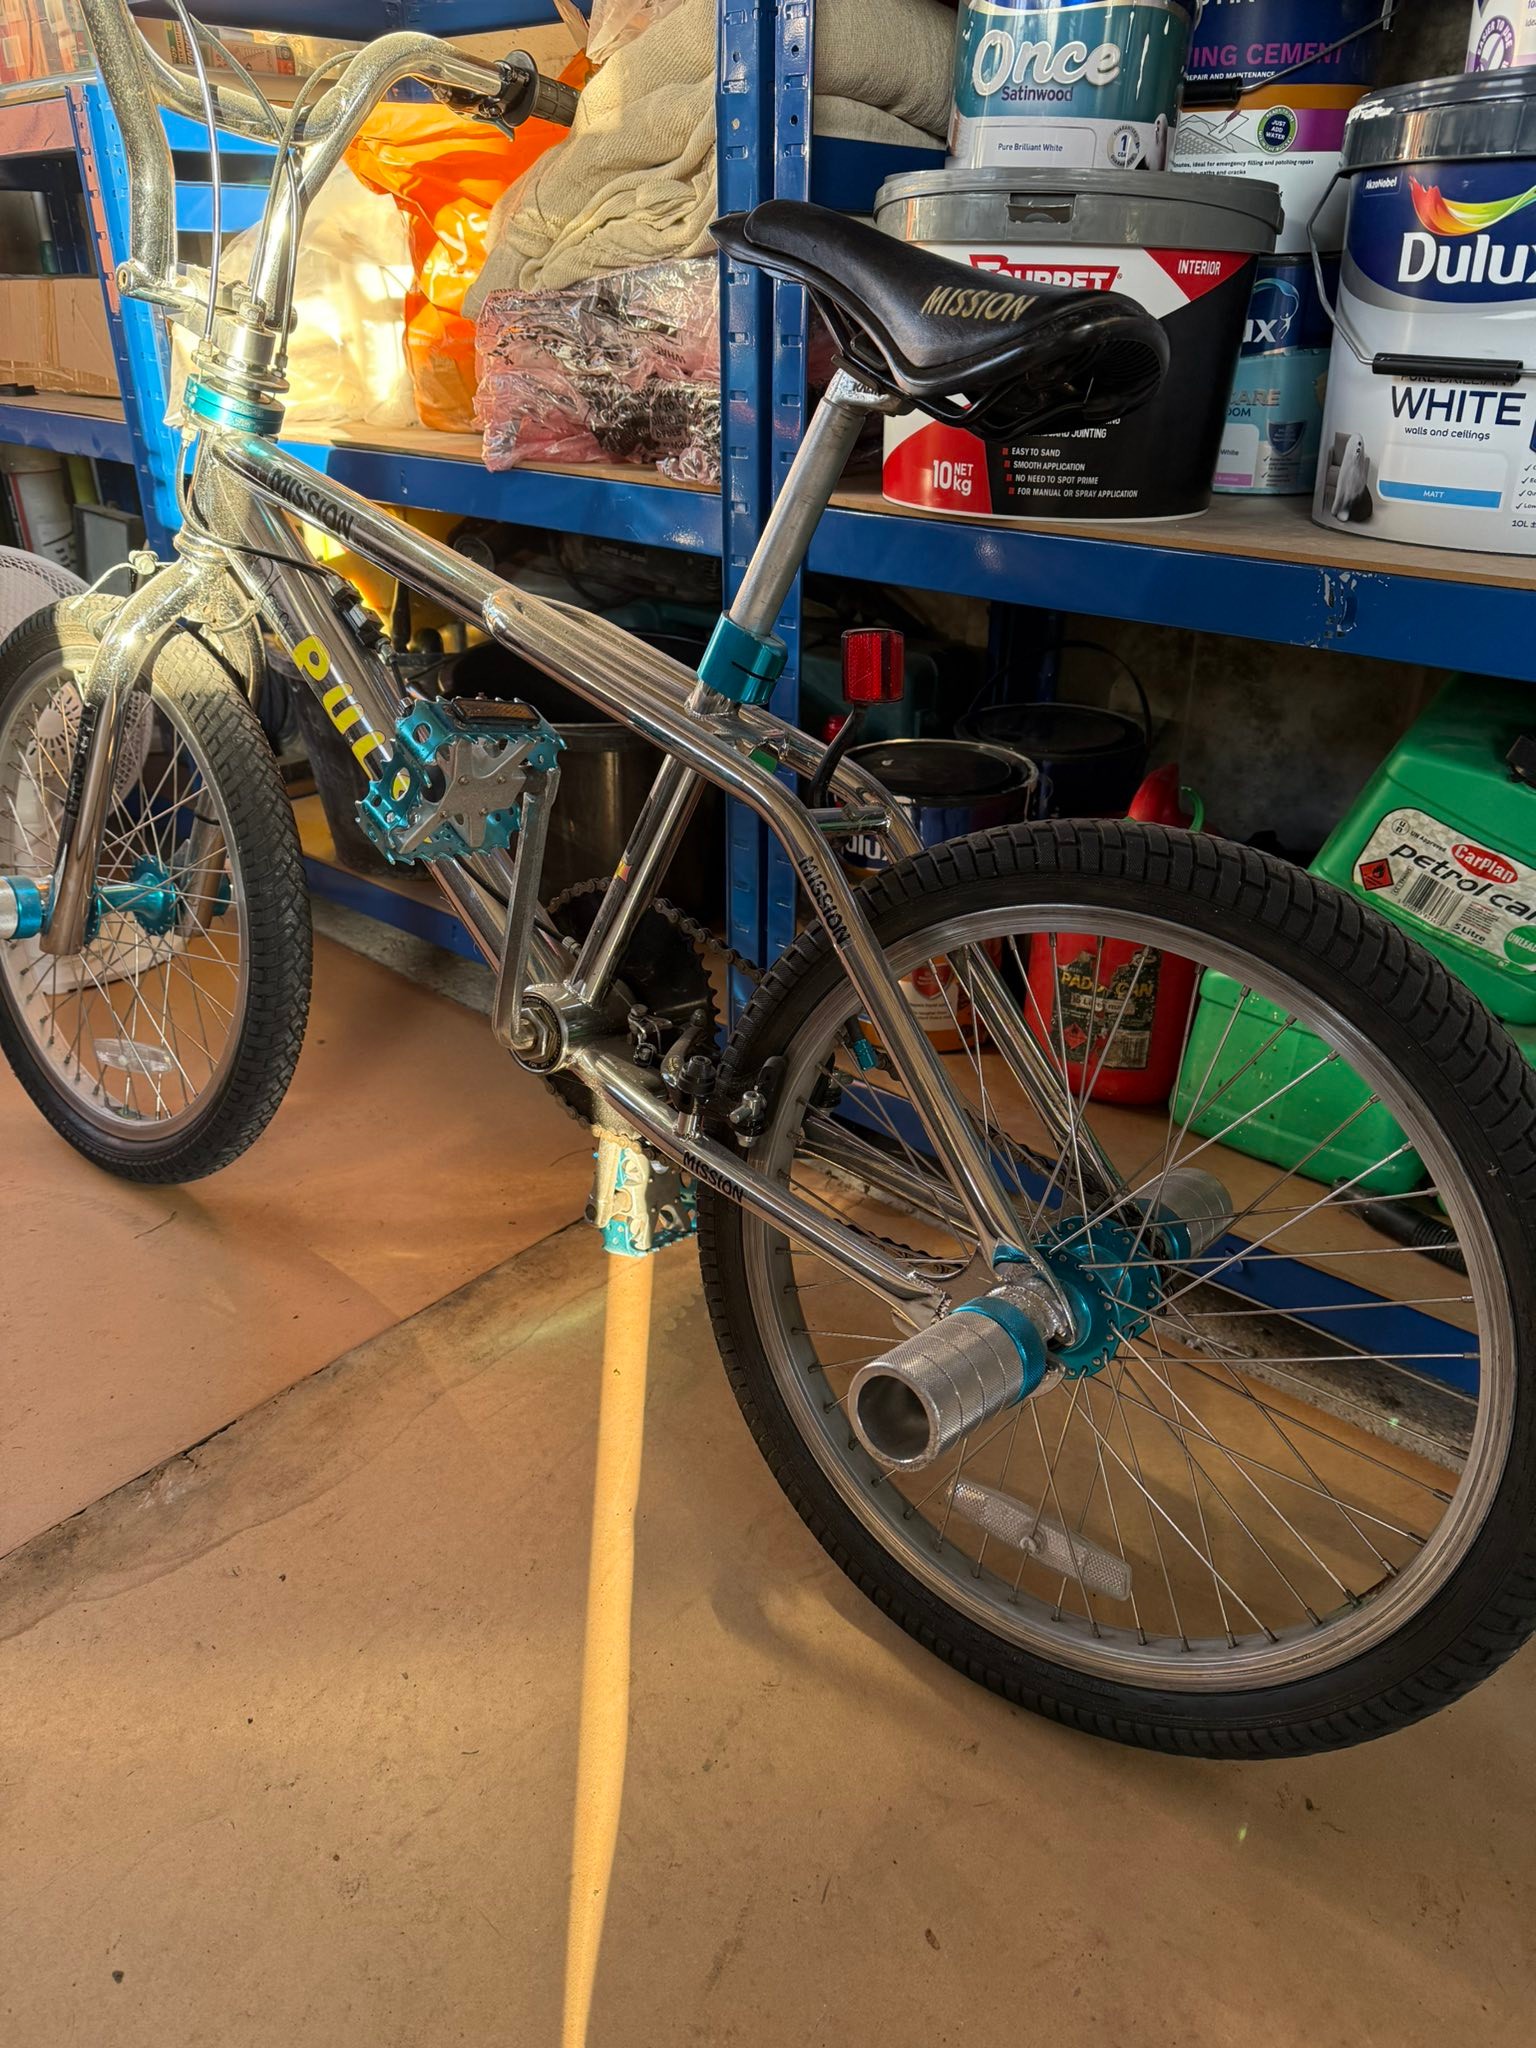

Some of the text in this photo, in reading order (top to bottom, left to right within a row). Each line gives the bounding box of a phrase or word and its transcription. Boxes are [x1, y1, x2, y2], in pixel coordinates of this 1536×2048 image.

[971, 29, 1121, 97] Once
[1187, 42, 1344, 68] ING CEMENT
[1209, 72, 1224, 81] AND
[1225, 70, 1276, 80] MAINTENANCE
[1001, 85, 1074, 102] Satinwood
[1265, 131, 1286, 140] WATER
[1270, 126, 1284, 134] ADD
[998, 143, 1063, 152] Pure Brilliant White
[1120, 134, 1129, 152] 1
[1192, 160, 1206, 168] ideal
[1206, 160, 1215, 168] for
[1216, 160, 1247, 169] emergency
[1247, 160, 1263, 168] filling
[1264, 159, 1275, 167] and
[1275, 159, 1297, 168] patching
[1297, 159, 1314, 167] repairs
[1364, 175, 1399, 191] AkzoNobel
[1177, 258, 1222, 277] INTERIOR
[920, 284, 1040, 322] MISSION
[1391, 385, 1527, 427] WHITE
[1404, 425, 1491, 442] walls and ceilings
[1011, 447, 1061, 457] EASY TO SAND
[1220, 448, 1239, 457] White
[953, 462, 974, 477] NET
[1013, 460, 1086, 471] SMOOTH APPLICATION
[933, 459, 953, 490] 10
[1015, 474, 1099, 485] NO NEED TO SPOT PRIME
[953, 475, 972, 497] kg
[1017, 487, 1139, 499] FOR MANUAL OR SPRAY APPLICATION
[1423, 490, 1445, 499] MATT
[265, 467, 355, 541] MISSION
[1512, 520, 1529, 529] 10L
[1410, 829, 1448, 853] UN Approved
[1389, 843, 1494, 897] petrol
[1454, 844, 1516, 884] CarPlan
[800, 855, 851, 949] MISSION
[1453, 922, 1462, 931] 5
[1460, 925, 1486, 943] Litre
[683, 1151, 744, 1204] MISSION
